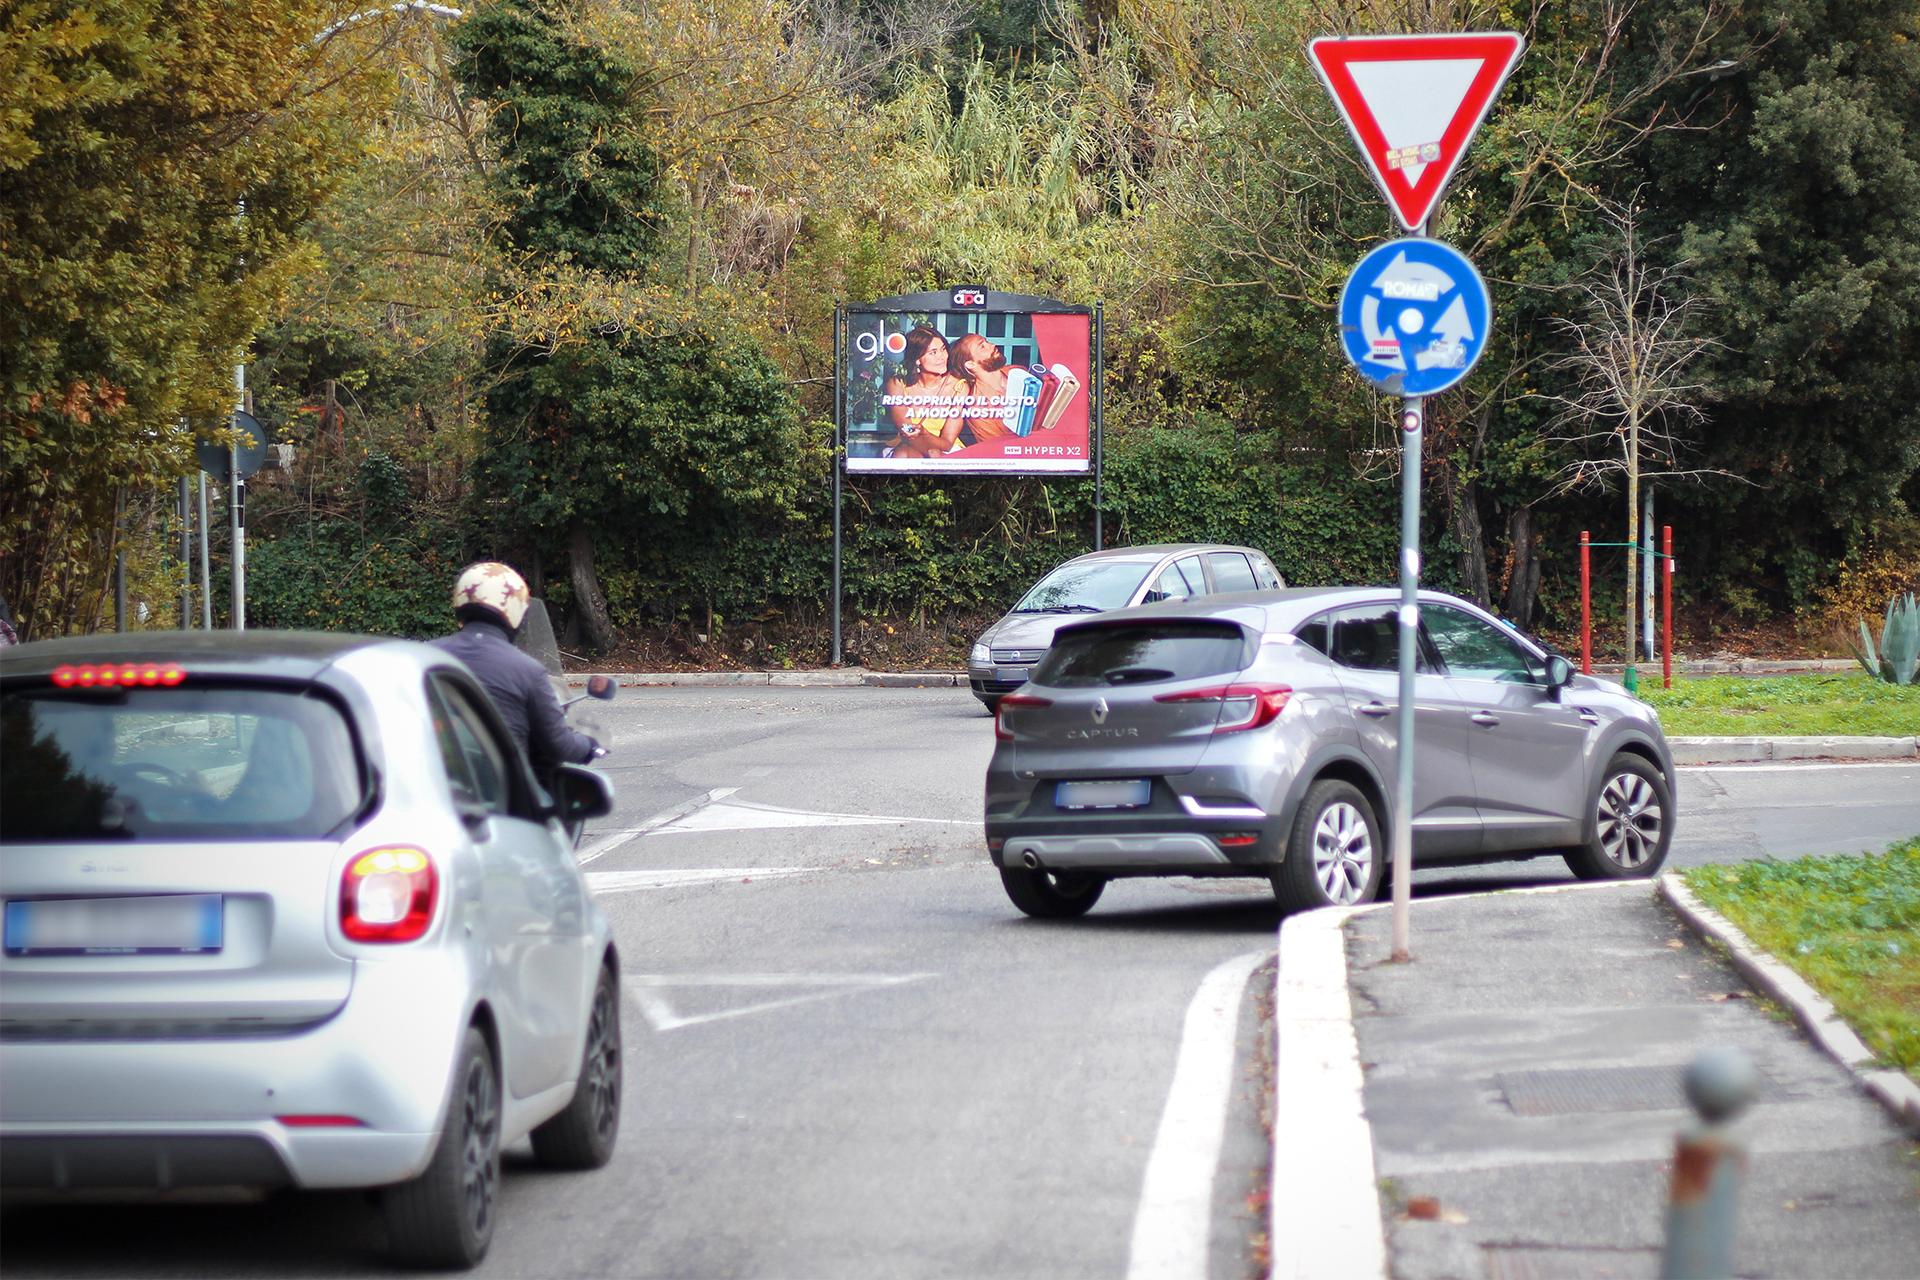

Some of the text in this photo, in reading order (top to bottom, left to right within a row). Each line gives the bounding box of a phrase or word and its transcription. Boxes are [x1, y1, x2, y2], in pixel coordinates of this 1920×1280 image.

[953, 293, 985, 306] apa
[856, 319, 907, 361] glo
[882, 395, 1038, 408] RISCOPRIAMO IL GUSTO,
[905, 408, 1016, 418] A MODO NOSTRO
[1025, 446, 1064, 455] HYPER
[1066, 446, 1081, 455] X2
[1067, 728, 1138, 739] CAPTUR
